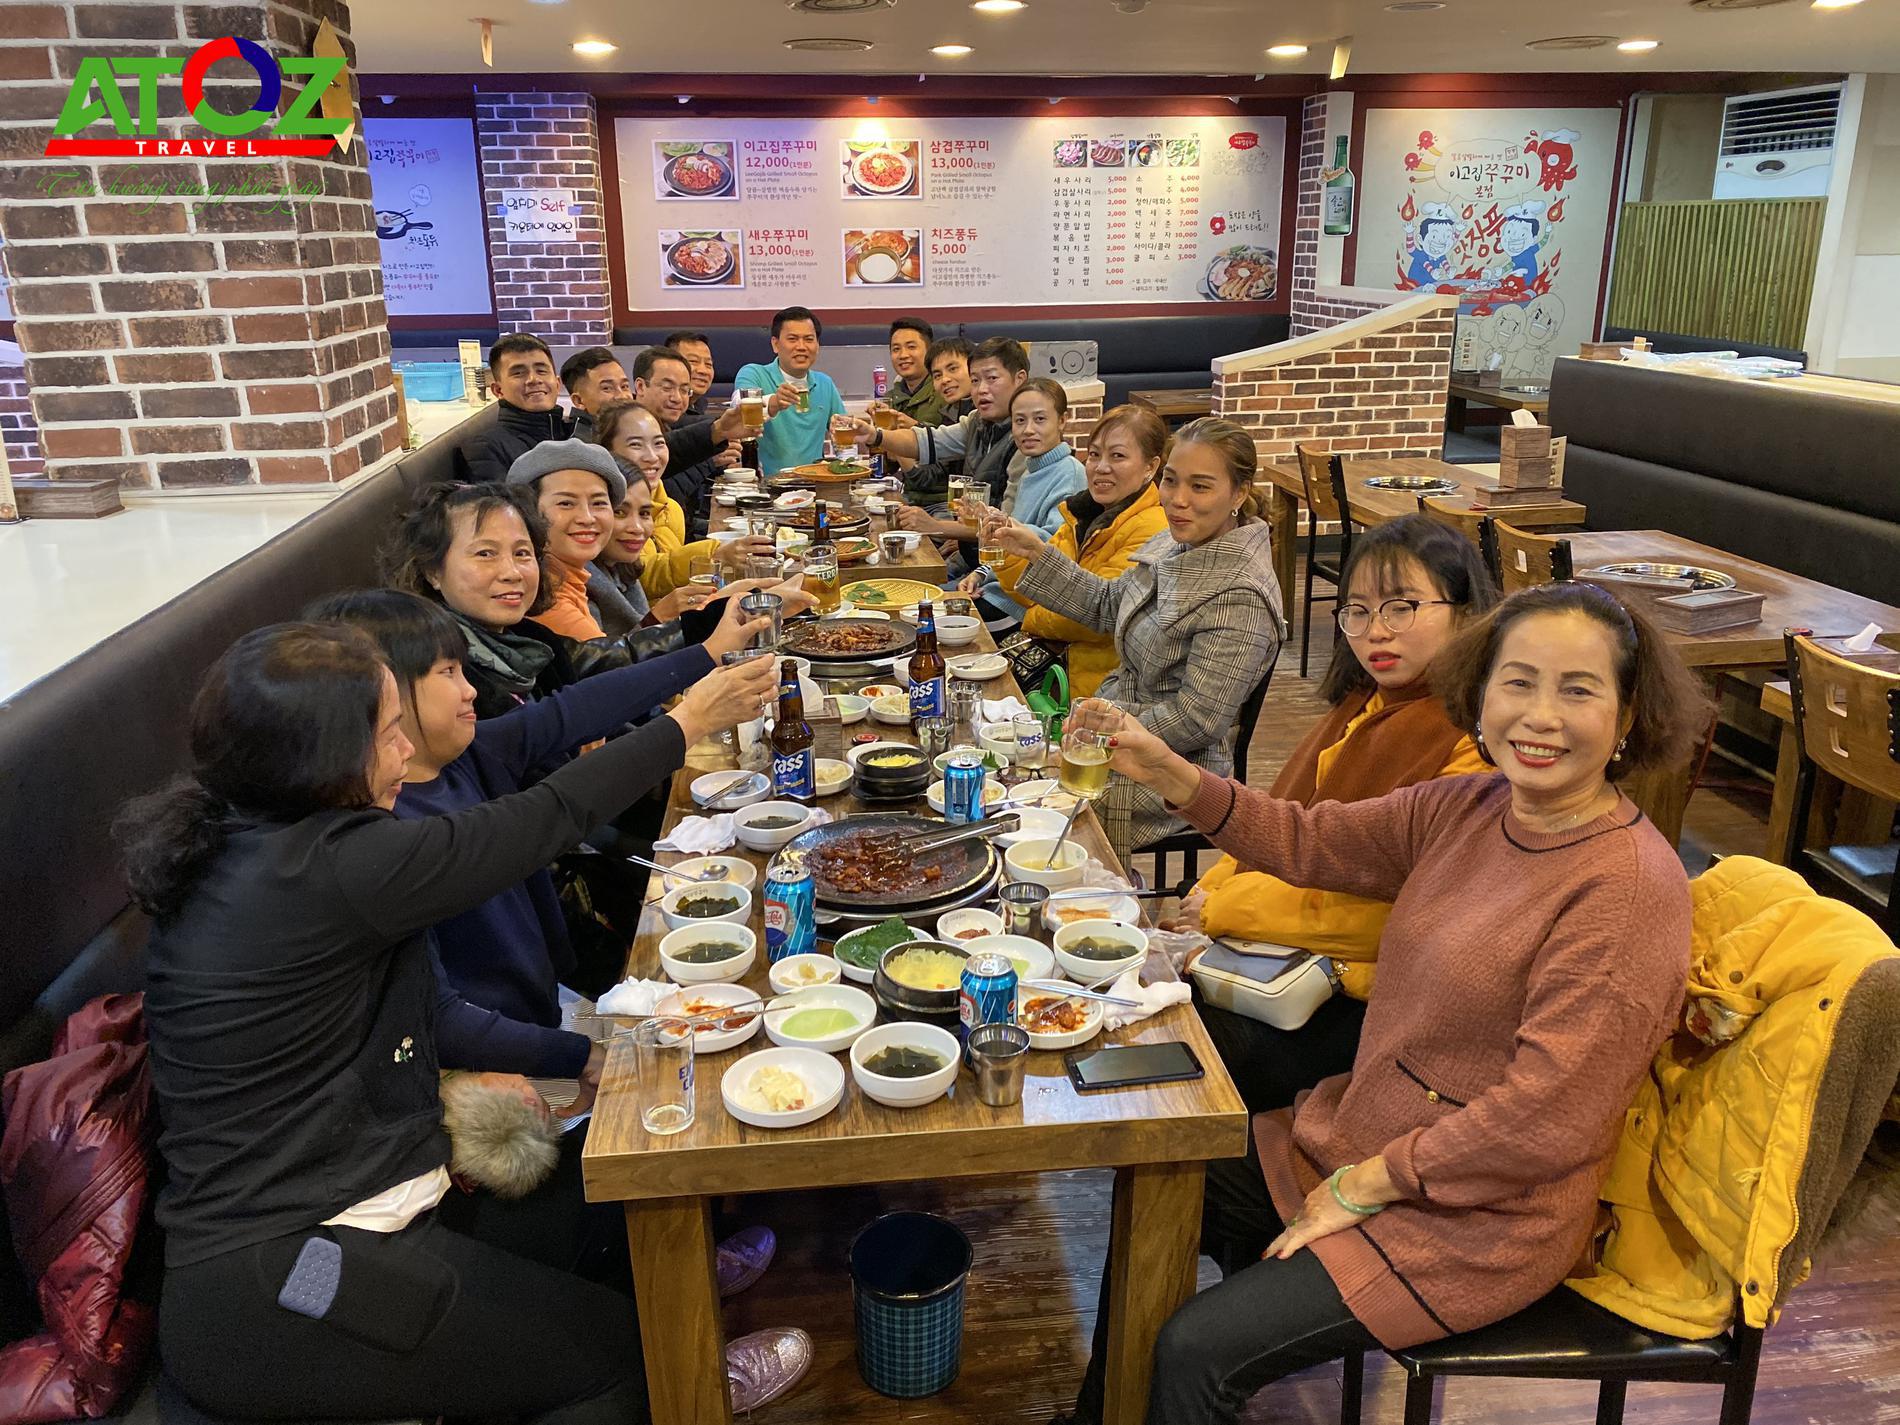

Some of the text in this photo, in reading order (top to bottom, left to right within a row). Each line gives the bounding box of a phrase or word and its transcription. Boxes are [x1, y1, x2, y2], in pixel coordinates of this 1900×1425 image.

[744, 141, 817, 154] 이고집쭈꾸미
[930, 140, 989, 154] 삼겹쭈꾸미
[1450, 163, 1530, 184] 이고집쭈꾸미
[541, 197, 565, 212] Self
[749, 229, 808, 242] 새우쭈꾸미
[931, 228, 979, 242] 치즈퐁듀
[931, 244, 967, 256] 5,000
